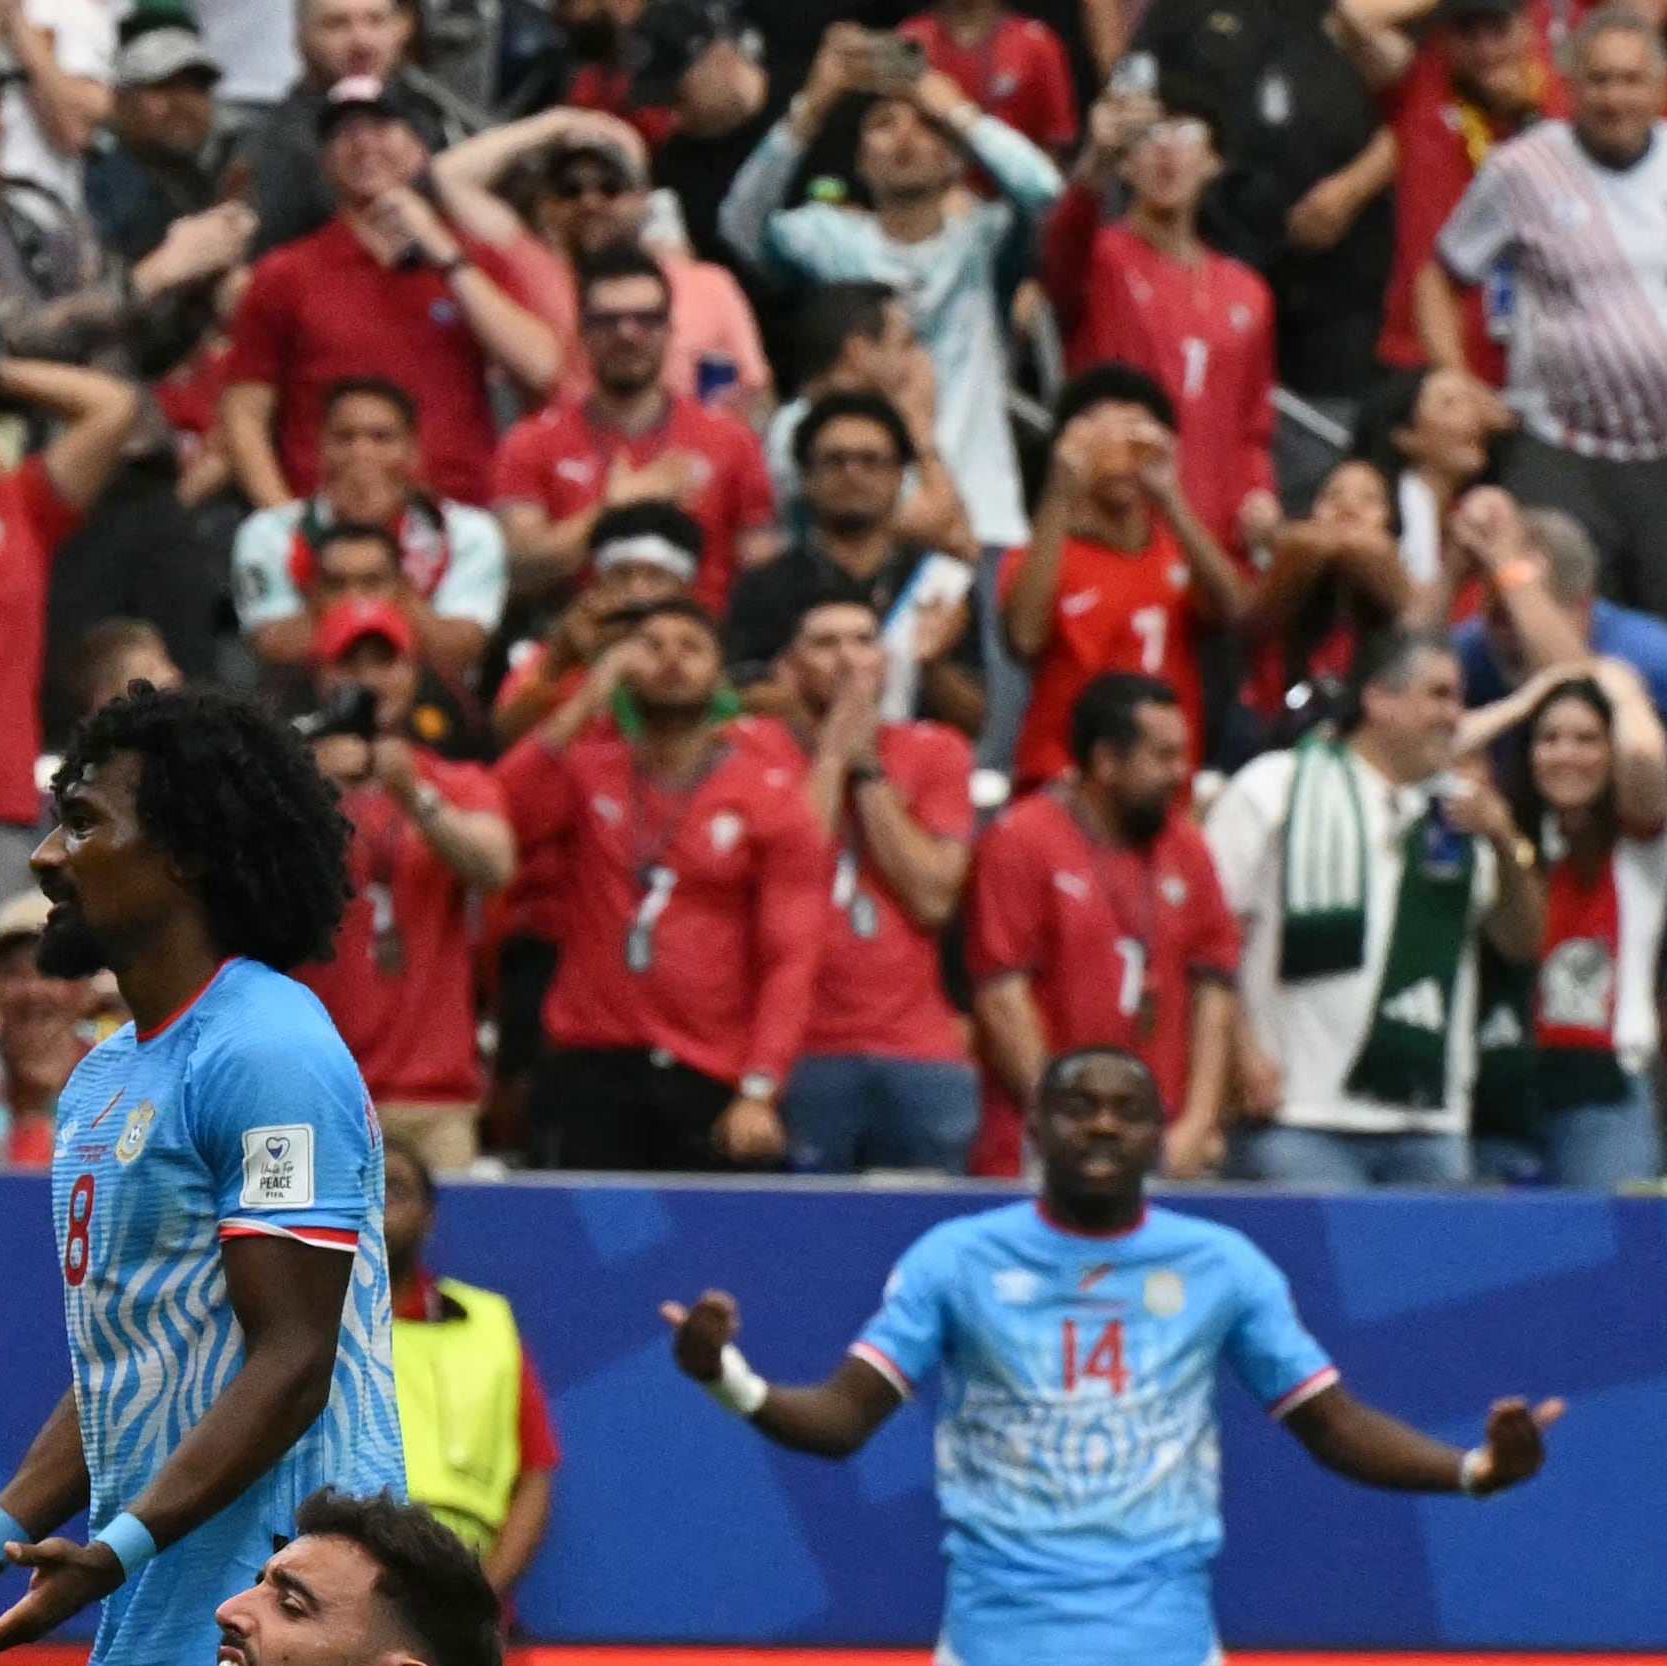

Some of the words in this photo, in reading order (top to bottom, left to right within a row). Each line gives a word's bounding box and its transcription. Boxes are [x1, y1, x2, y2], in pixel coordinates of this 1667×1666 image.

[260, 1175, 292, 1190] PEACE
[64, 1173, 95, 1287] 8
[1061, 1316, 1131, 1397] 14
